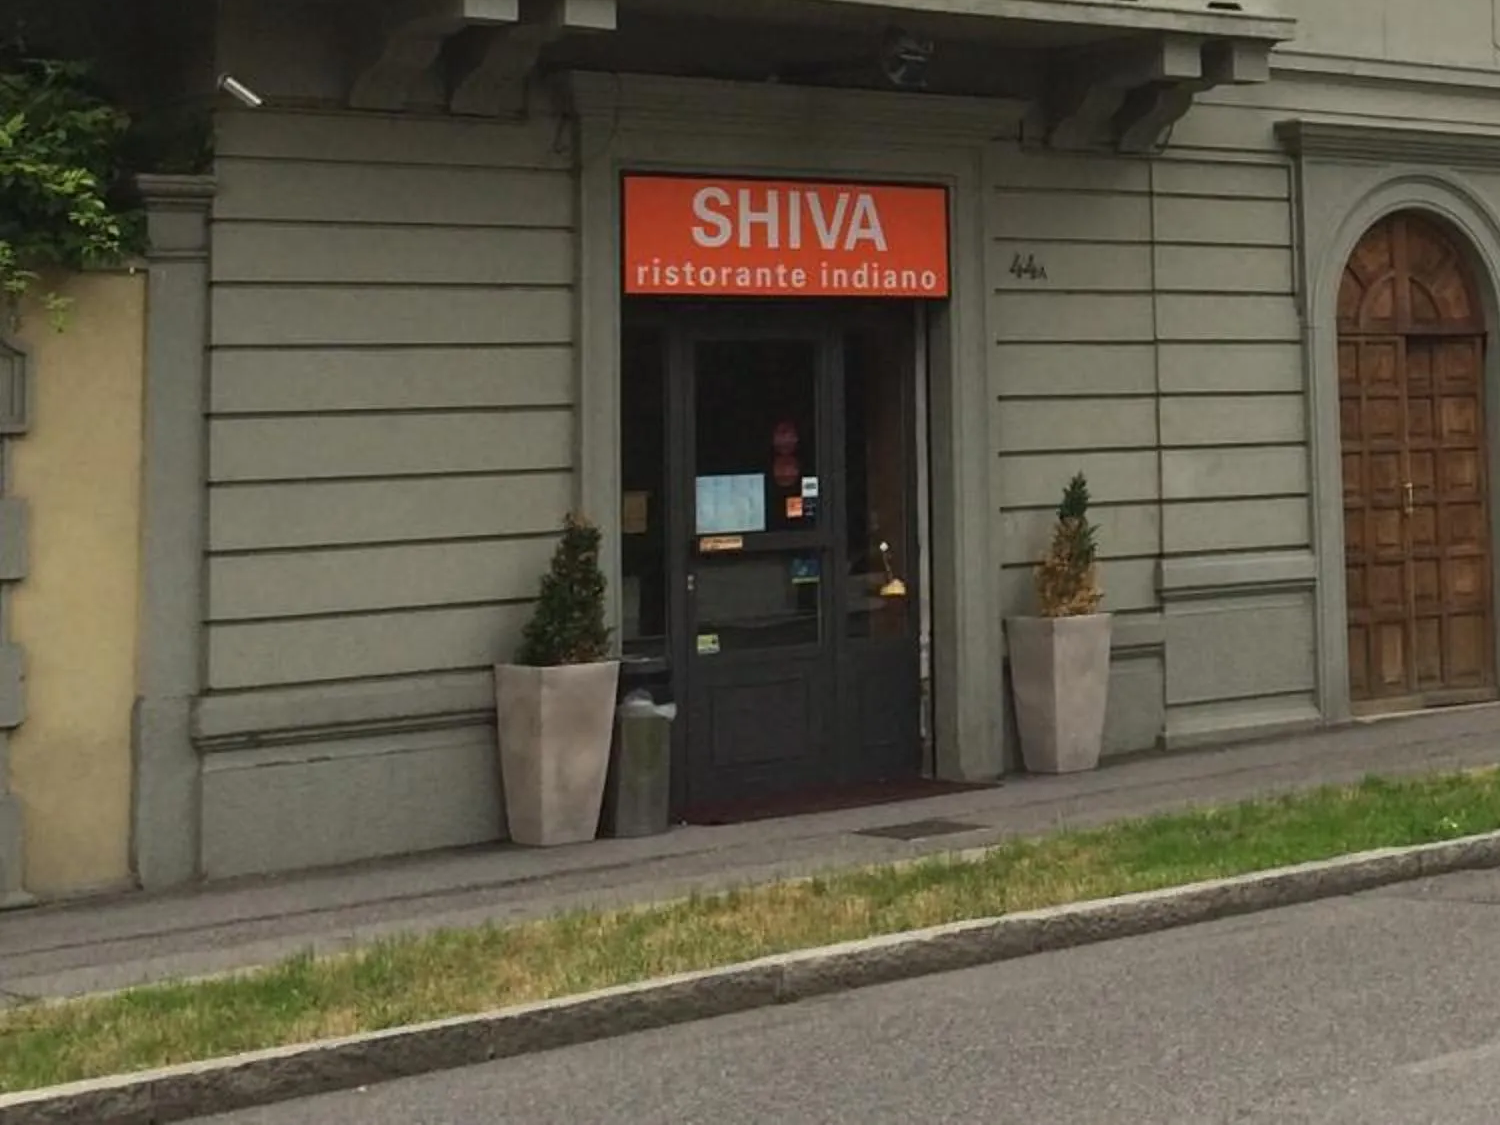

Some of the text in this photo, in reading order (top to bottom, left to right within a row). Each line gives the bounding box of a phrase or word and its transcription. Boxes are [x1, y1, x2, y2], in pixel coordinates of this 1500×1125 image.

[691, 186, 888, 252] SHIVA
[637, 258, 937, 290] ristorante indiano
